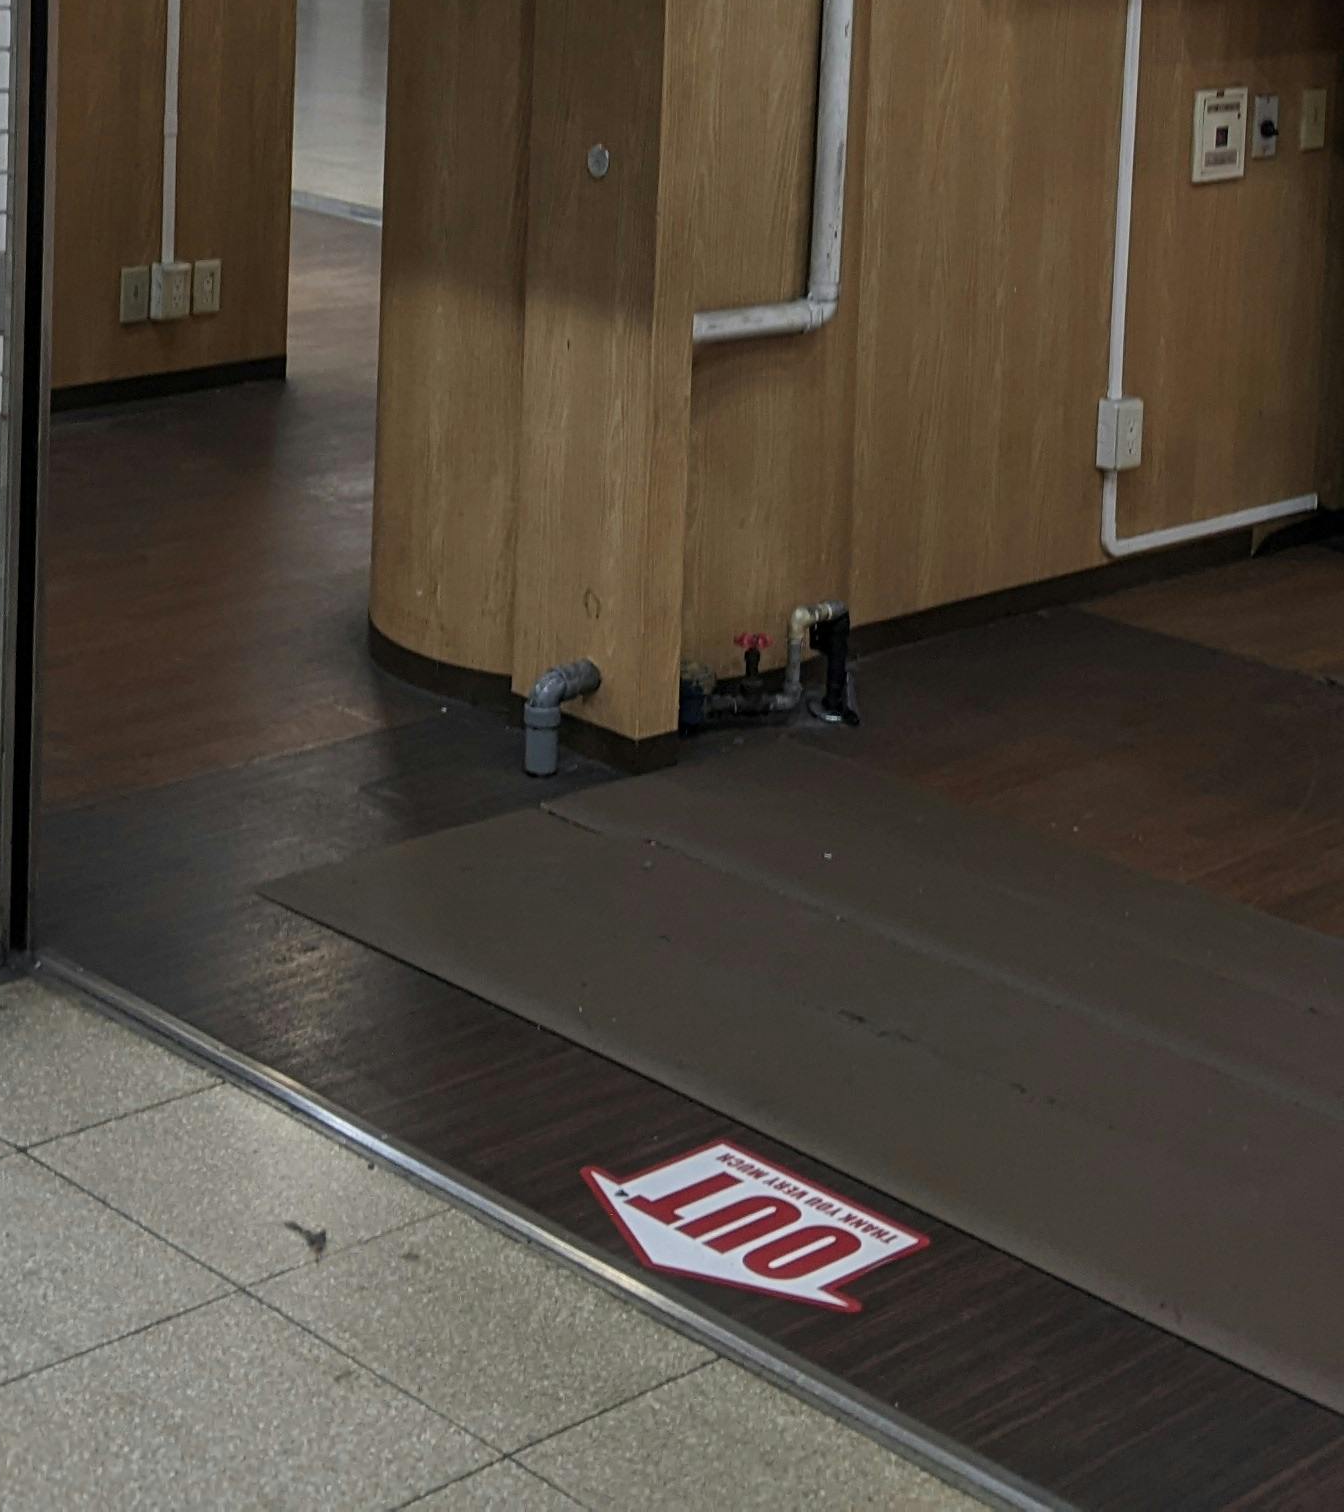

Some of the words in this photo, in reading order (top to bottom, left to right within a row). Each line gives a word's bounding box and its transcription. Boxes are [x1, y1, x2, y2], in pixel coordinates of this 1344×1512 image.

[715, 1152, 770, 1180] MUCH
[763, 1175, 810, 1200] VERY
[805, 1196, 846, 1218] YOU
[623, 1171, 863, 1280] OUT
[838, 1212, 898, 1244] THANK
